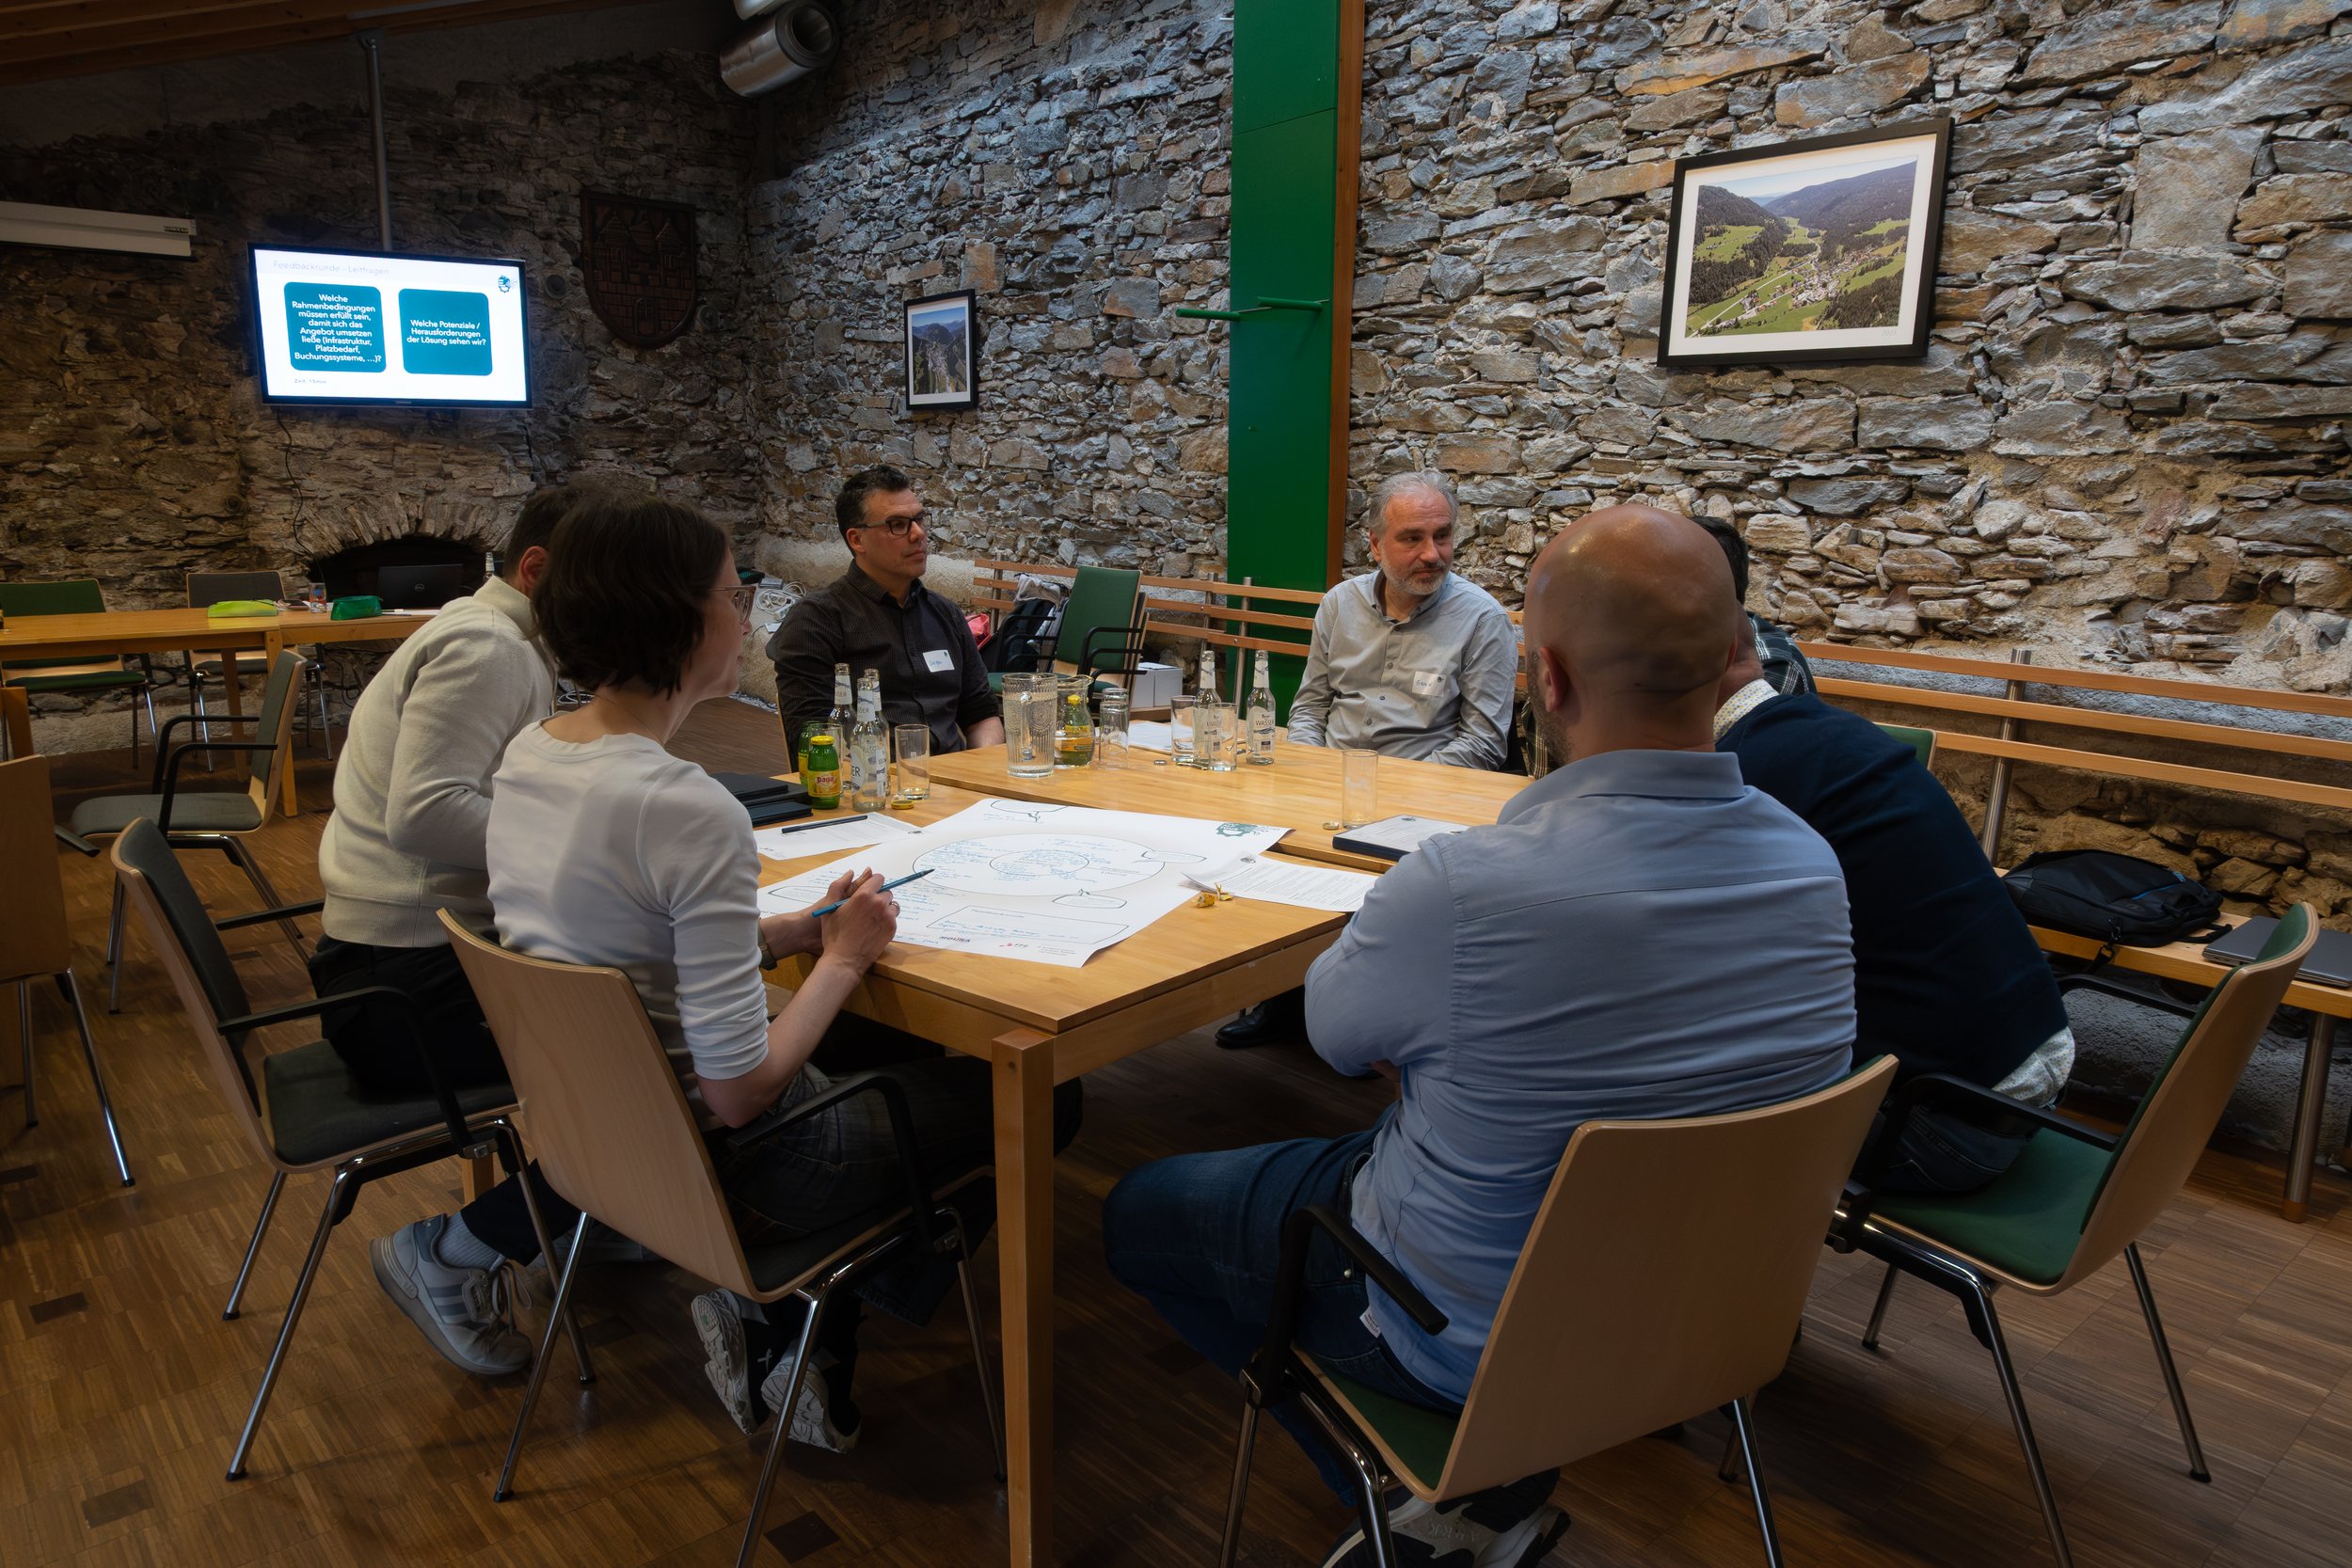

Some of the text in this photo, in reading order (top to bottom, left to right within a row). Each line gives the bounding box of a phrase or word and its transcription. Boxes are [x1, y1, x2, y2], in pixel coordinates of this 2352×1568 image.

[318, 293, 348, 303] Welche
[292, 300, 375, 313] Rahmenbedingungen
[329, 310, 353, 320] erfüllt
[353, 312, 371, 322] sein,
[308, 319, 331, 327] damit
[409, 319, 438, 328] Welche
[438, 321, 475, 329] Potenziale
[300, 326, 373, 338] Angebot umsetzen
[411, 327, 481, 339] Herausforderungen
[301, 335, 373, 346] ließe (Infrastruktur,
[406, 335, 420, 343] der
[421, 336, 448, 346] Lösung
[315, 344, 360, 354] Platzbedarf,
[294, 352, 365, 363] Buchungssysteme,
